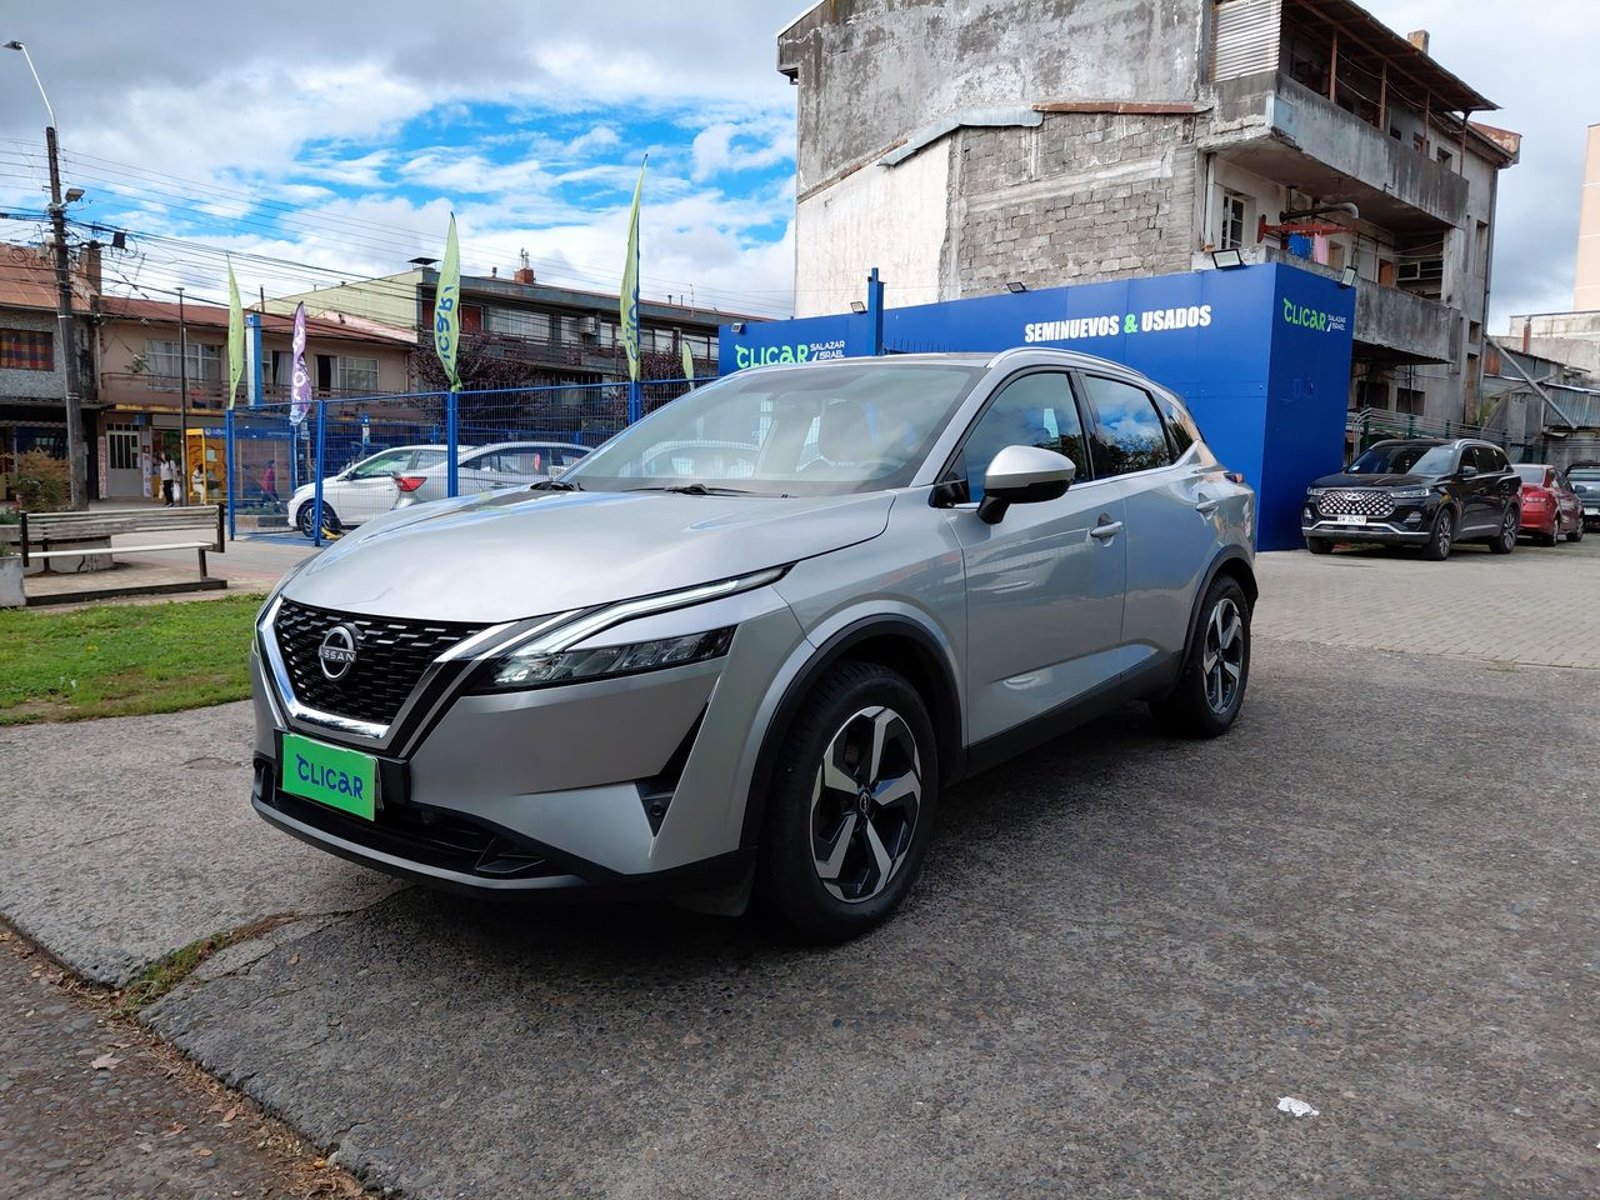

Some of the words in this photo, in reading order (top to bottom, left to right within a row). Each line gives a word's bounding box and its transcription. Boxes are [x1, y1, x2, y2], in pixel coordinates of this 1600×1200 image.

[1025, 315, 1119, 343] SEMINUEVOS
[1123, 313, 1138, 334] &
[1141, 304, 1211, 332] USADOS
[810, 340, 845, 351] SALAZAR
[819, 350, 845, 360] ISRAEL
